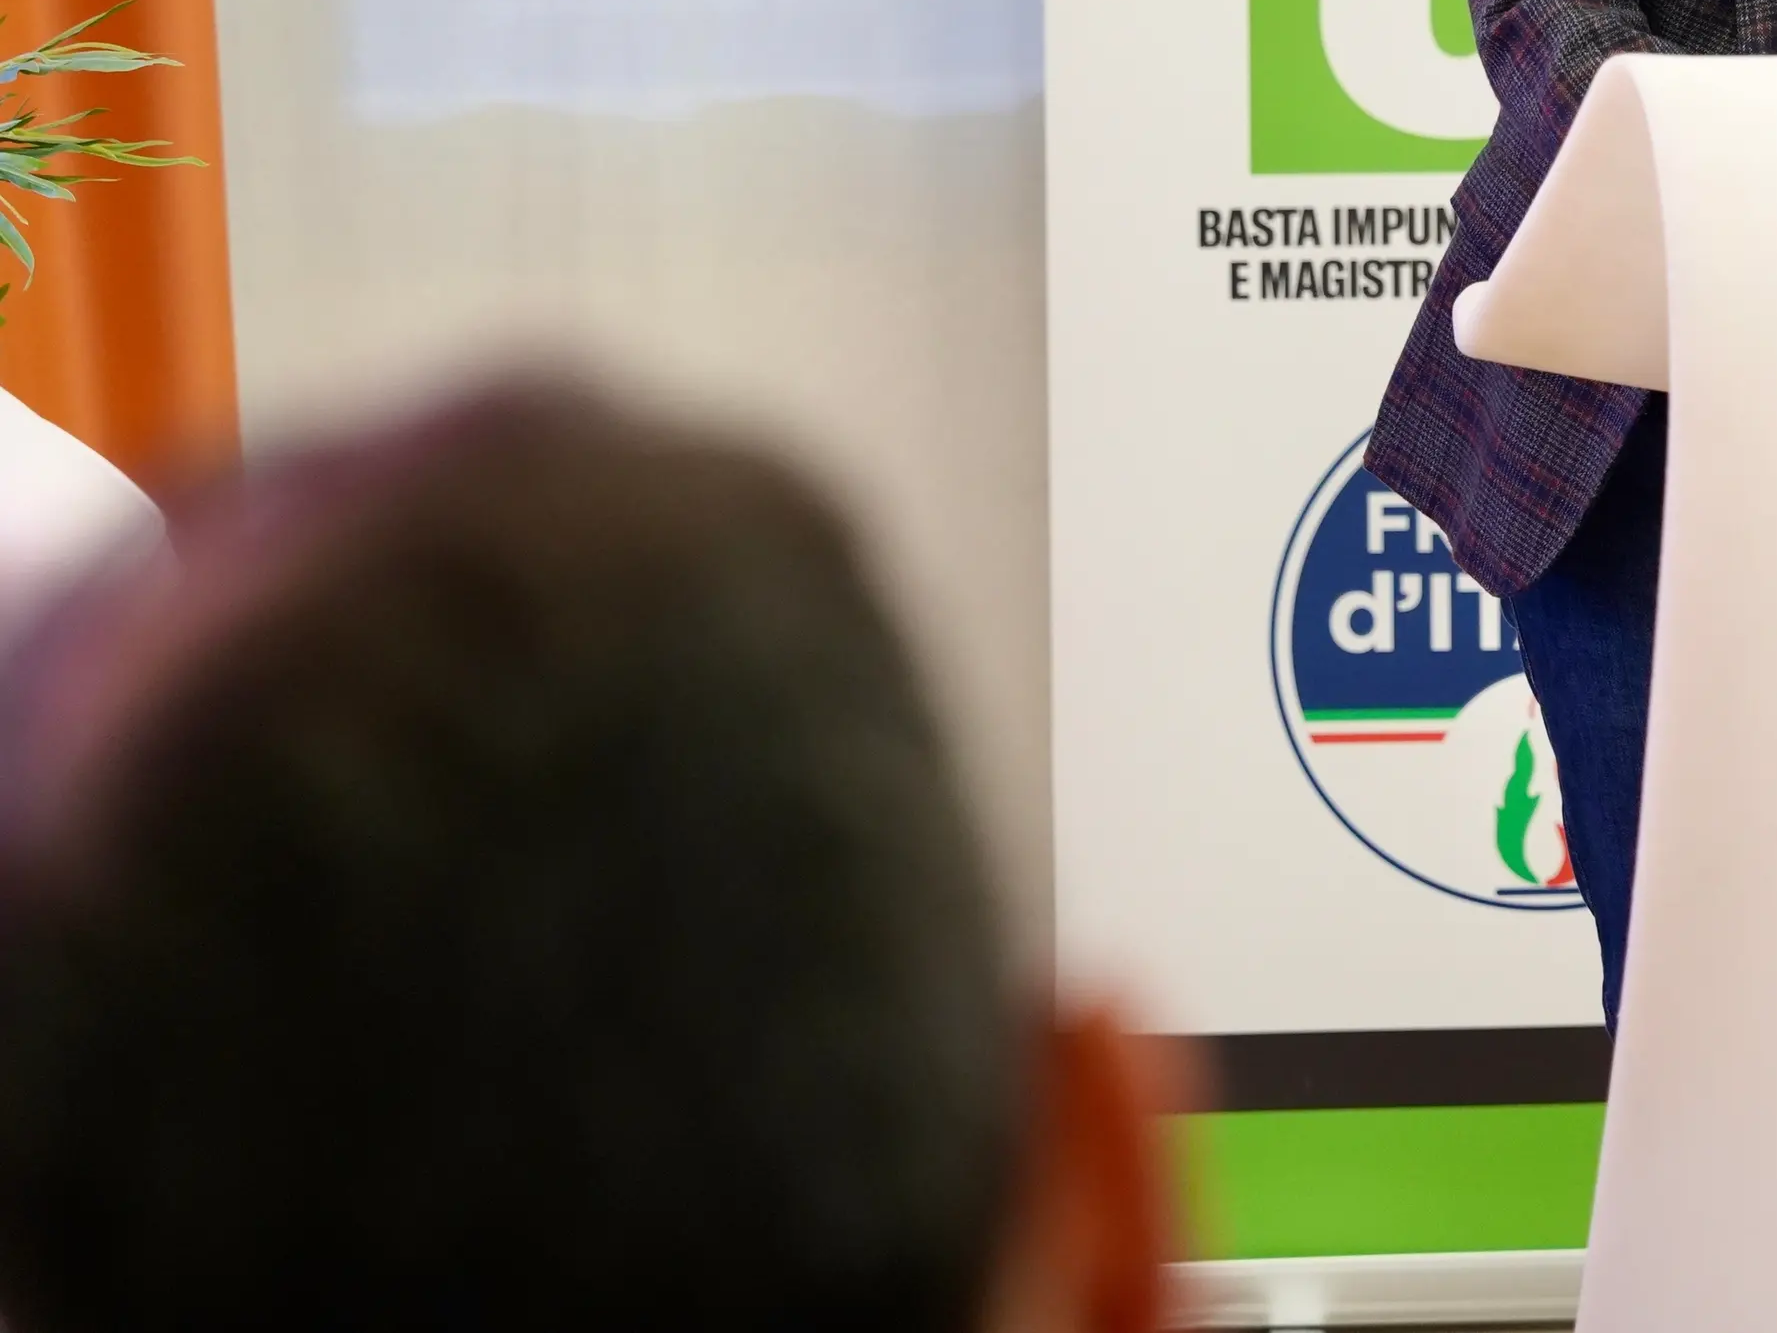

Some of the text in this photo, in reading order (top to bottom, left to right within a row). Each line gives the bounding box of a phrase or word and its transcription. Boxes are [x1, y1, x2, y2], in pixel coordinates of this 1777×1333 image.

[1198, 207, 1458, 248] BASTA IMPUN
[1230, 259, 1434, 300] E MAGISTR
[1328, 570, 1520, 655] d'IT
